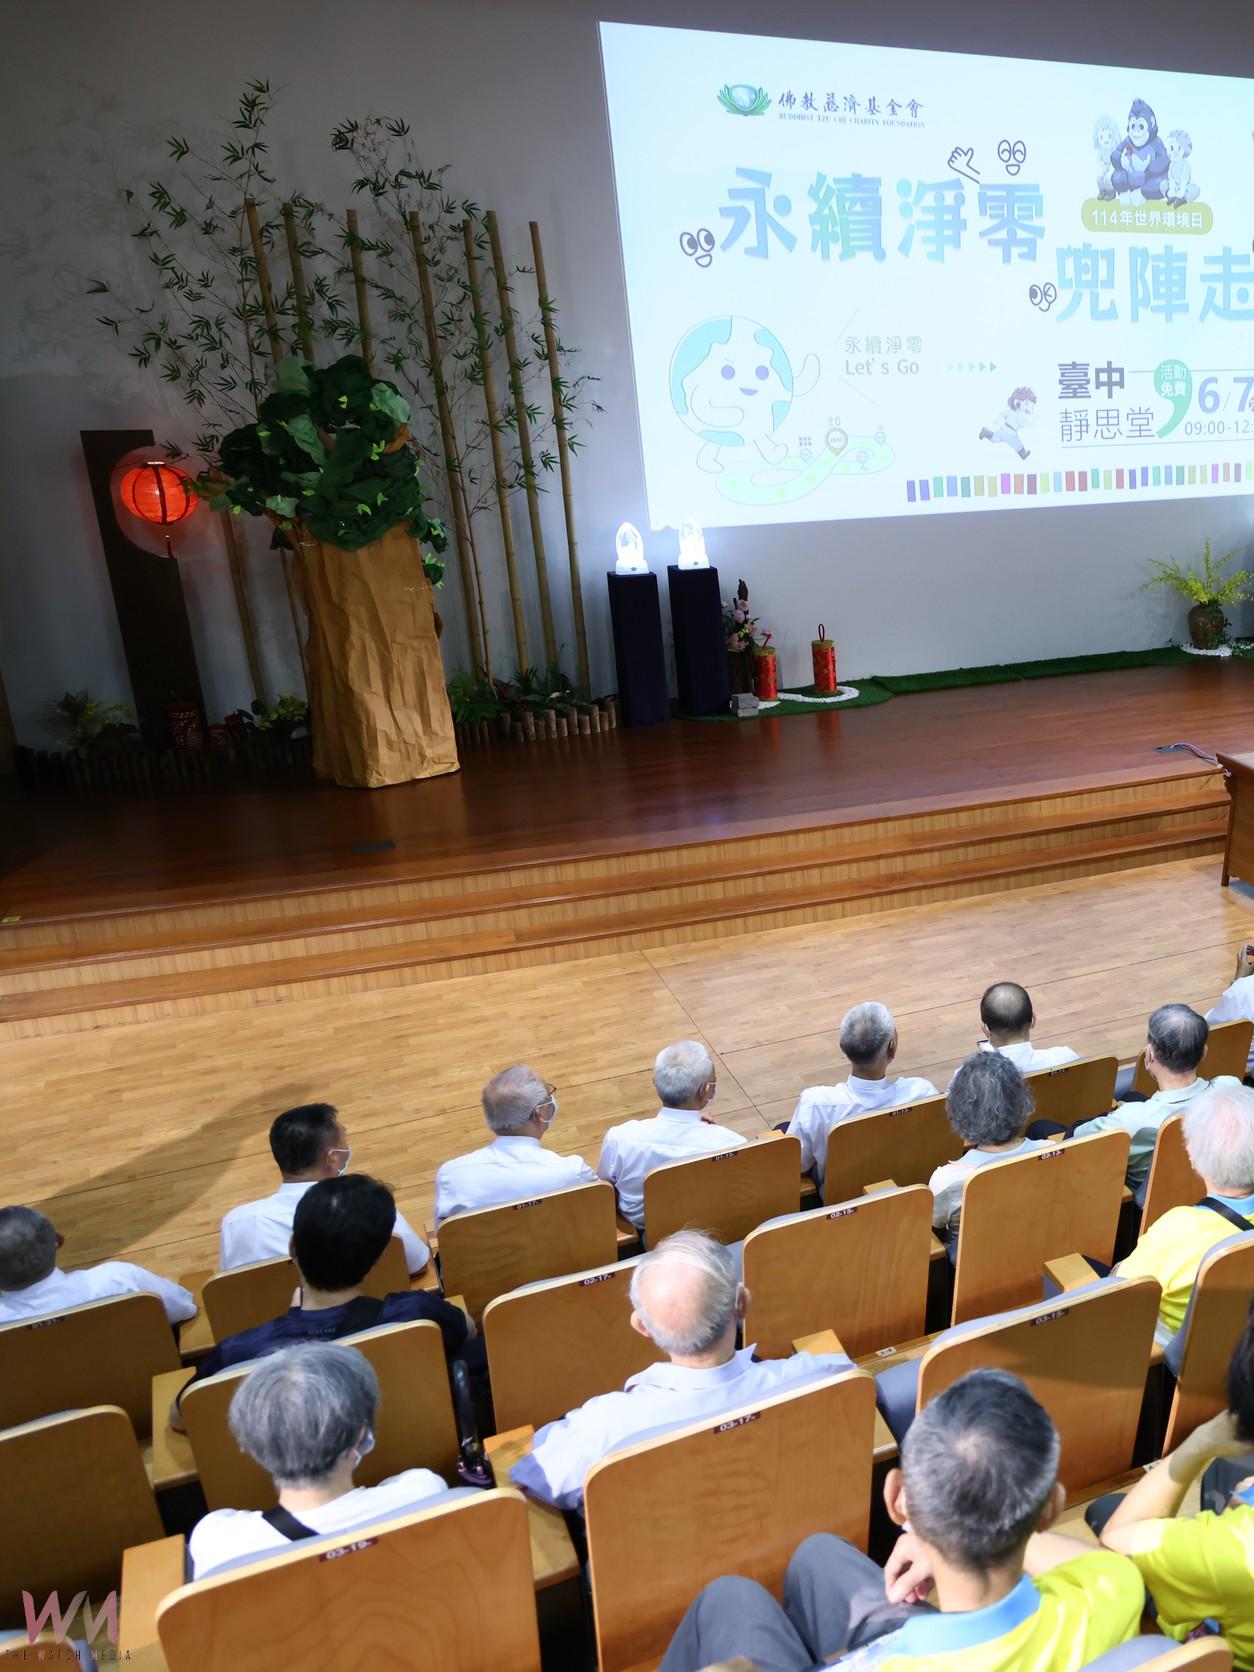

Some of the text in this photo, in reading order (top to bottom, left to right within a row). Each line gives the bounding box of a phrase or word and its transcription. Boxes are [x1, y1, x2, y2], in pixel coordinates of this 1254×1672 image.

[778, 89, 924, 119] 佛教慈濟基金會
[779, 112, 814, 122] BUDDHIST
[833, 116, 847, 124] CHI
[849, 117, 880, 127] CHARITY
[882, 119, 926, 129] FOUNDATION
[718, 166, 1046, 265] 永續淨零
[897, 358, 920, 376] Go
[1057, 360, 1126, 400] 臺中
[1160, 364, 1188, 380] 活動
[1059, 406, 1156, 443] 靜思堂
